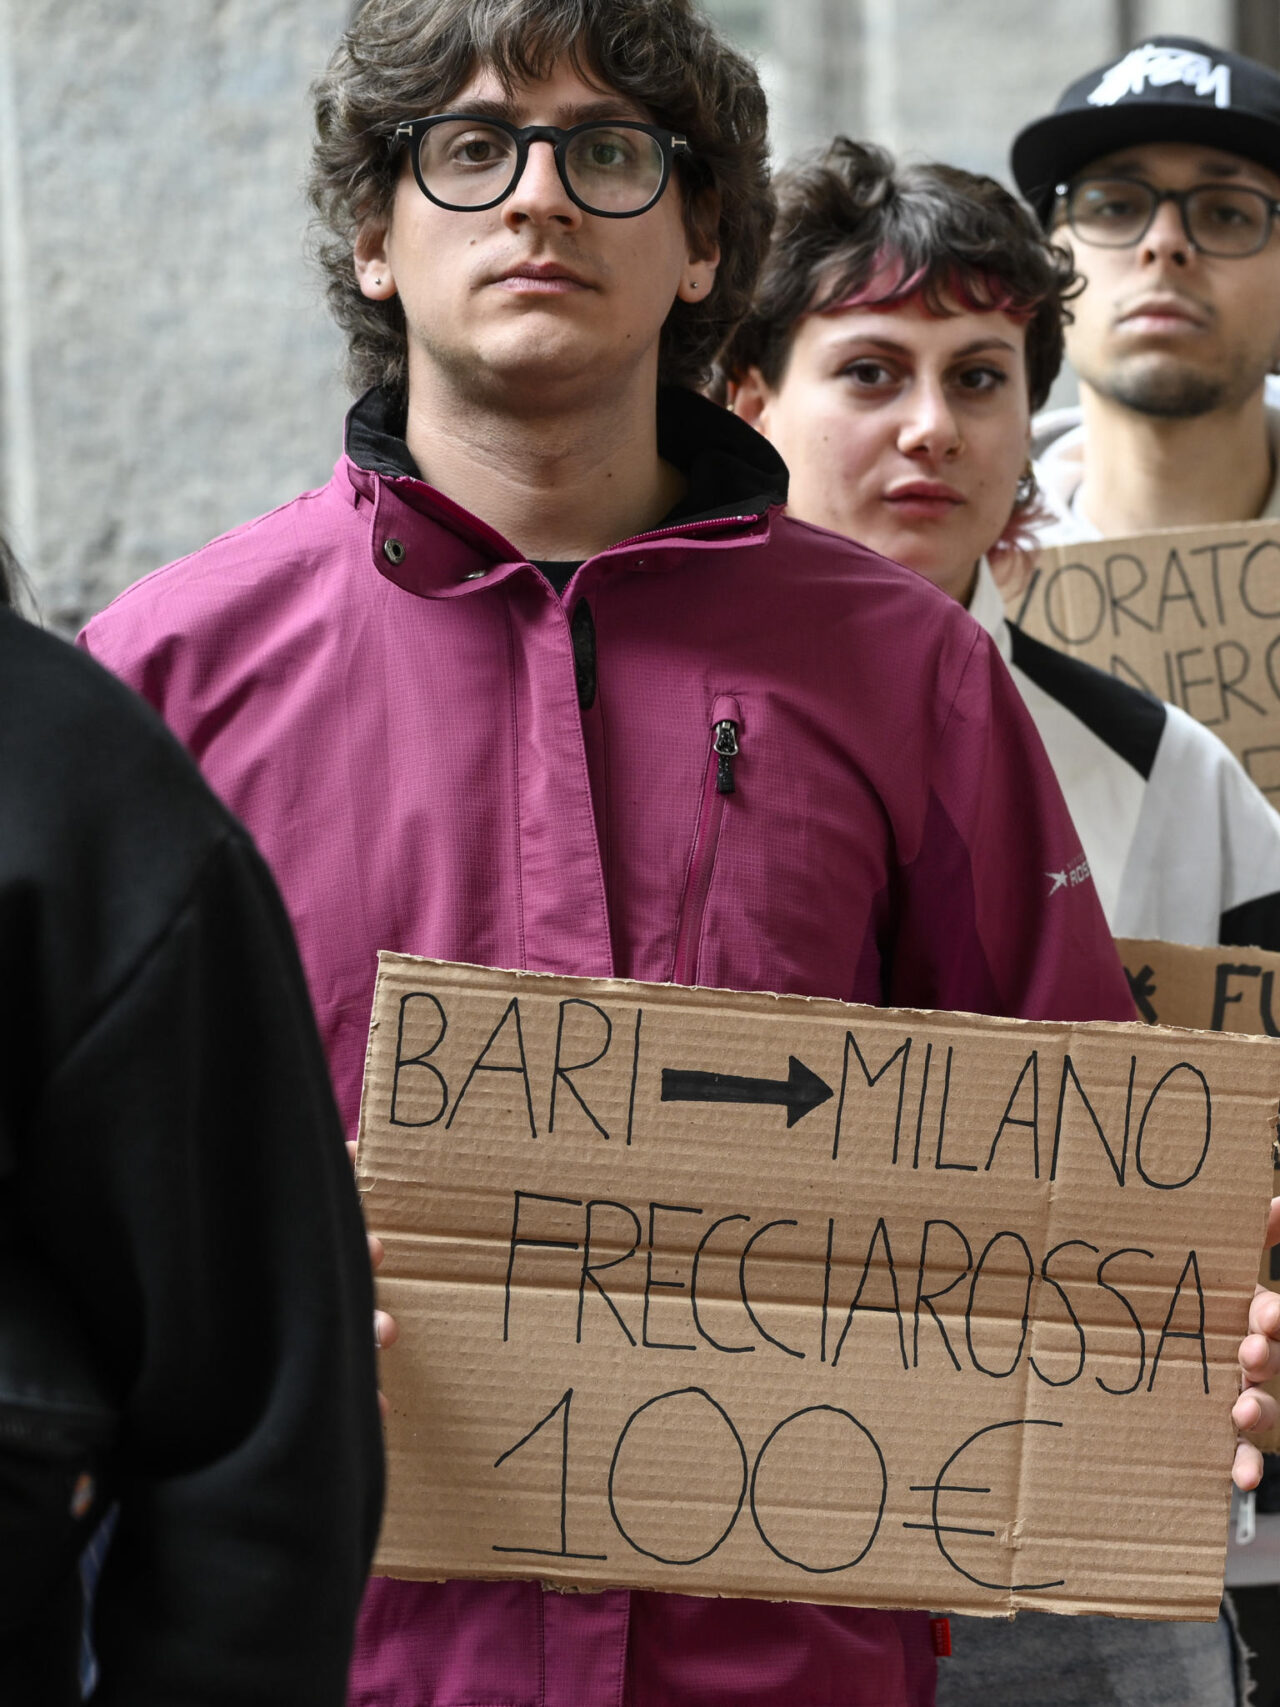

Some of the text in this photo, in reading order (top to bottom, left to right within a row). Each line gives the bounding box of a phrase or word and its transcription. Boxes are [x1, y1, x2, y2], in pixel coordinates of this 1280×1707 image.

[389, 992, 1213, 1189] BARI MILANO
[503, 1190, 1210, 1396] FRECCIAROSSA
[491, 1386, 1066, 1590] 100€
